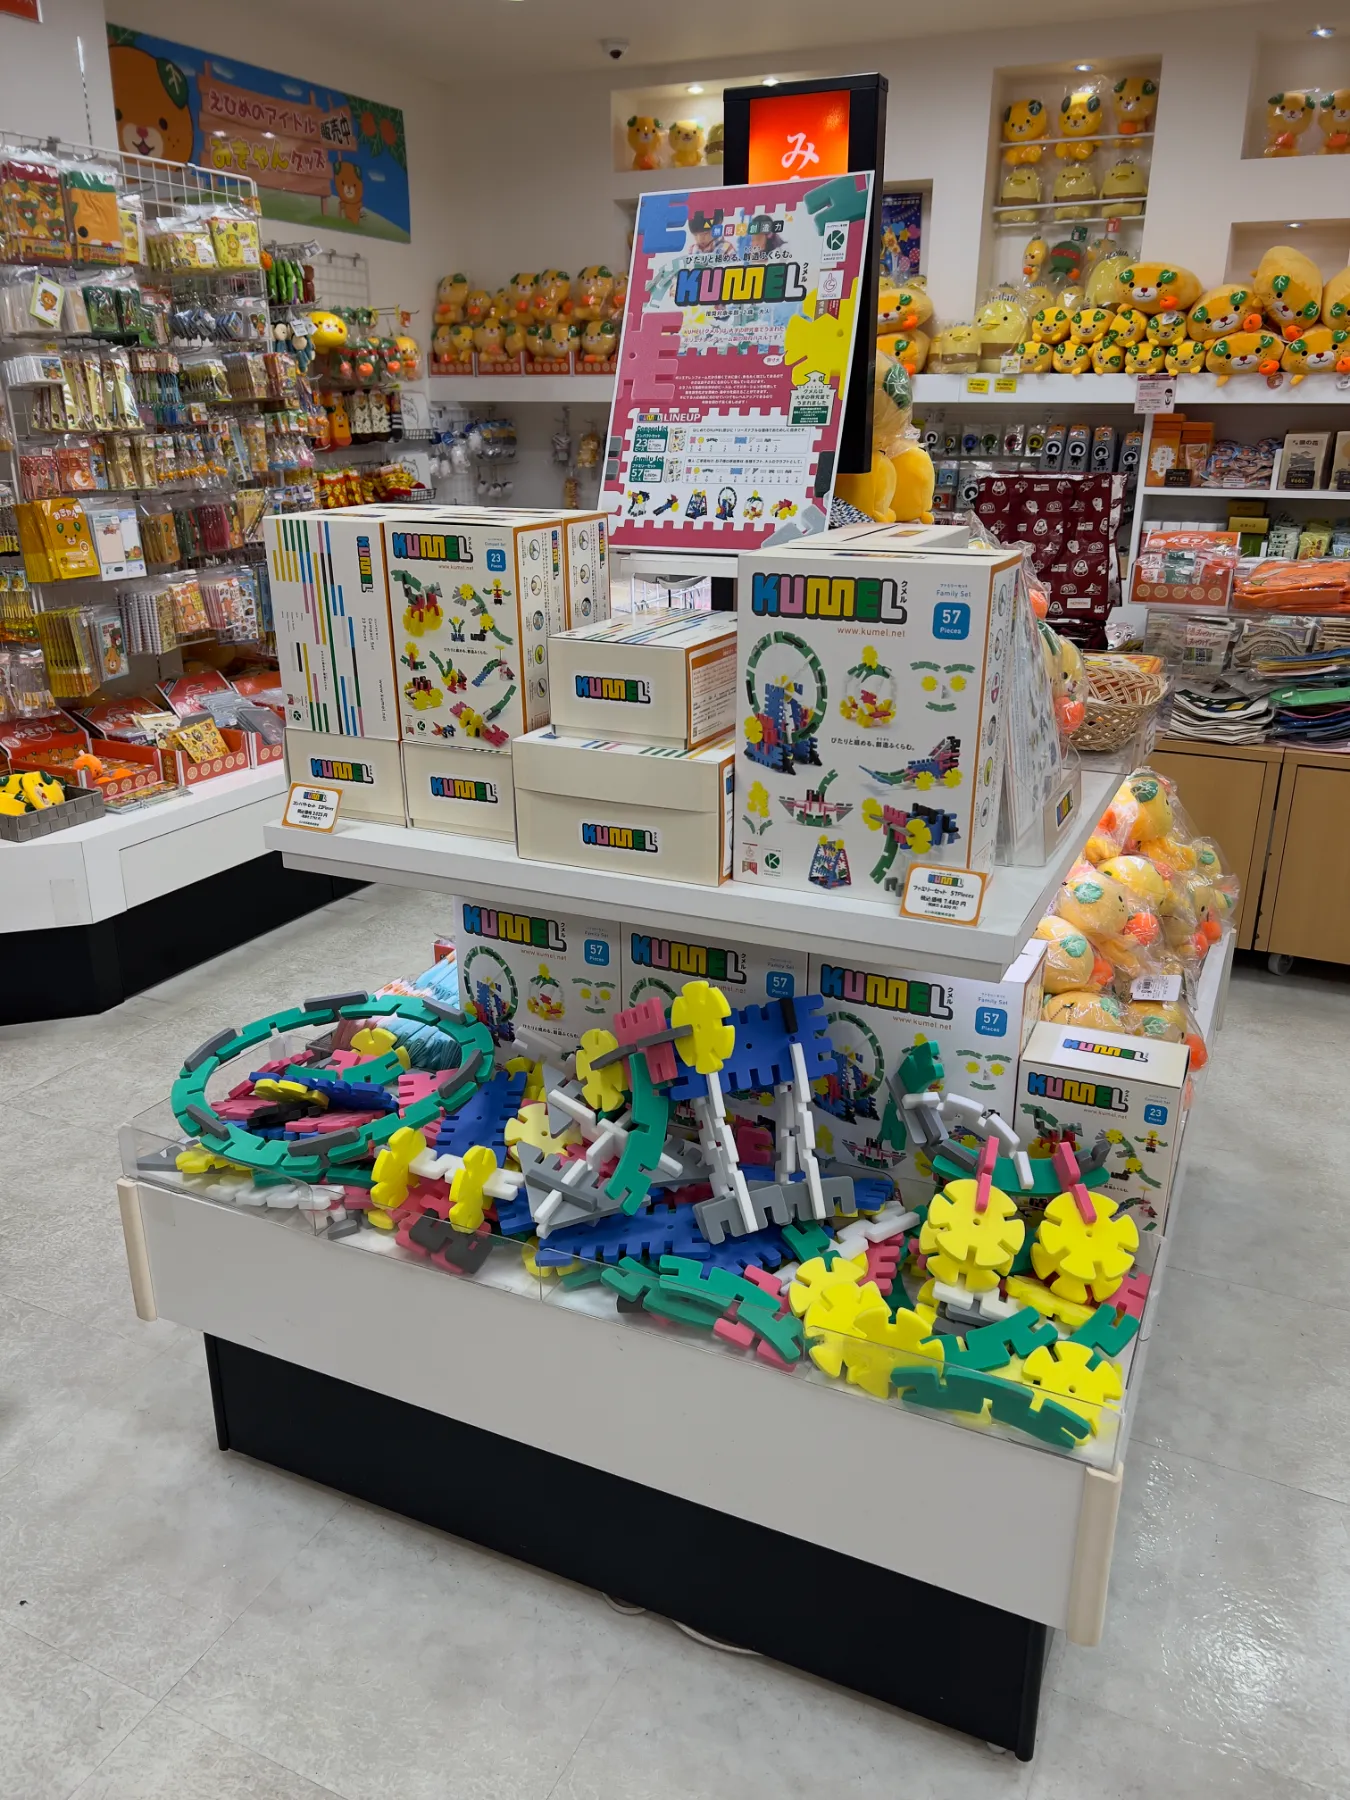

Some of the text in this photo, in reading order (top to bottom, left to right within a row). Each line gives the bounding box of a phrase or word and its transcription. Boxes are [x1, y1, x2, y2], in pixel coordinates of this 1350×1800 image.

[209, 90, 316, 134] えひめのアイドル
[320, 112, 351, 146] 販売中
[782, 132, 819, 180] み
[801, 262, 809, 283] クメル
[675, 262, 807, 306] KUMEL
[663, 413, 701, 422] LINEUP
[635, 438, 648, 447] 23
[631, 468, 644, 477] 57
[392, 532, 473, 563] KUMEL
[491, 553, 501, 563] 23
[356, 536, 373, 593] KUMEL
[752, 572, 907, 625] KUMEL
[900, 580, 908, 604] クメル
[936, 589, 972, 598] Family Set
[942, 609, 961, 624] 57
[837, 626, 906, 638] www.kumel.net
[940, 626, 962, 635] Pieces
[575, 675, 651, 704] KUMEL
[310, 757, 374, 785] KUMEL
[430, 776, 498, 804] KUMEL
[582, 823, 658, 853] KUMEL
[928, 874, 964, 888] KUMEL
[463, 903, 567, 952] KUMEL
[590, 945, 603, 955] 57
[631, 932, 747, 985] KUMEL
[773, 976, 788, 988] 57
[820, 963, 954, 1021] KUMEL
[978, 996, 1008, 1006] Family Set
[892, 1014, 952, 1031] www.kumel.net
[981, 1025, 1000, 1033] Pieces
[983, 1012, 1000, 1025] 57
[1063, 1038, 1148, 1063] KUMEL
[1027, 1072, 1128, 1113] KUMEL
[1150, 1108, 1162, 1117] 23
